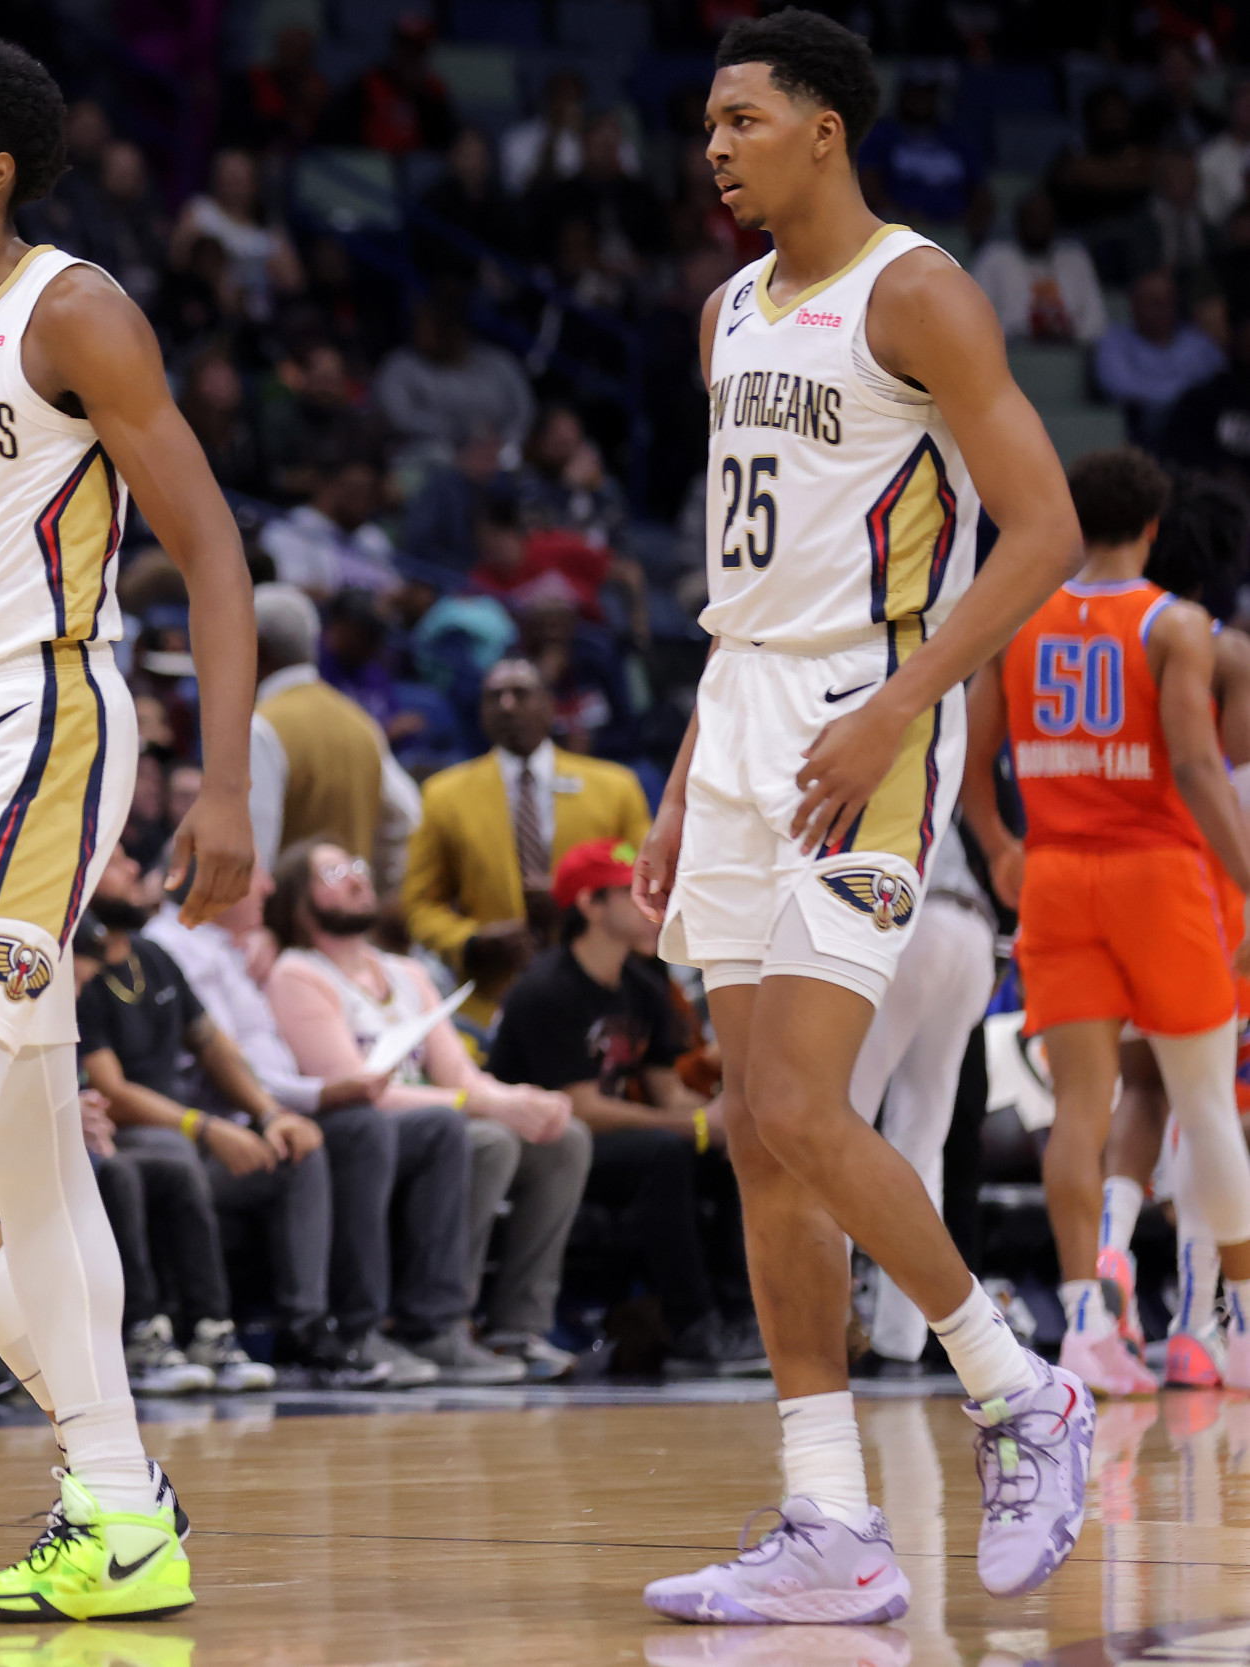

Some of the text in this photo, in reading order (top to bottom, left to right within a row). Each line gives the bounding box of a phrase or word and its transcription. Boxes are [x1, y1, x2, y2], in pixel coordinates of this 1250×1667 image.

[796, 308, 843, 328] ibotta
[734, 371, 842, 446] ORLEANS
[721, 454, 779, 572] 25
[1033, 633, 1126, 738] 50
